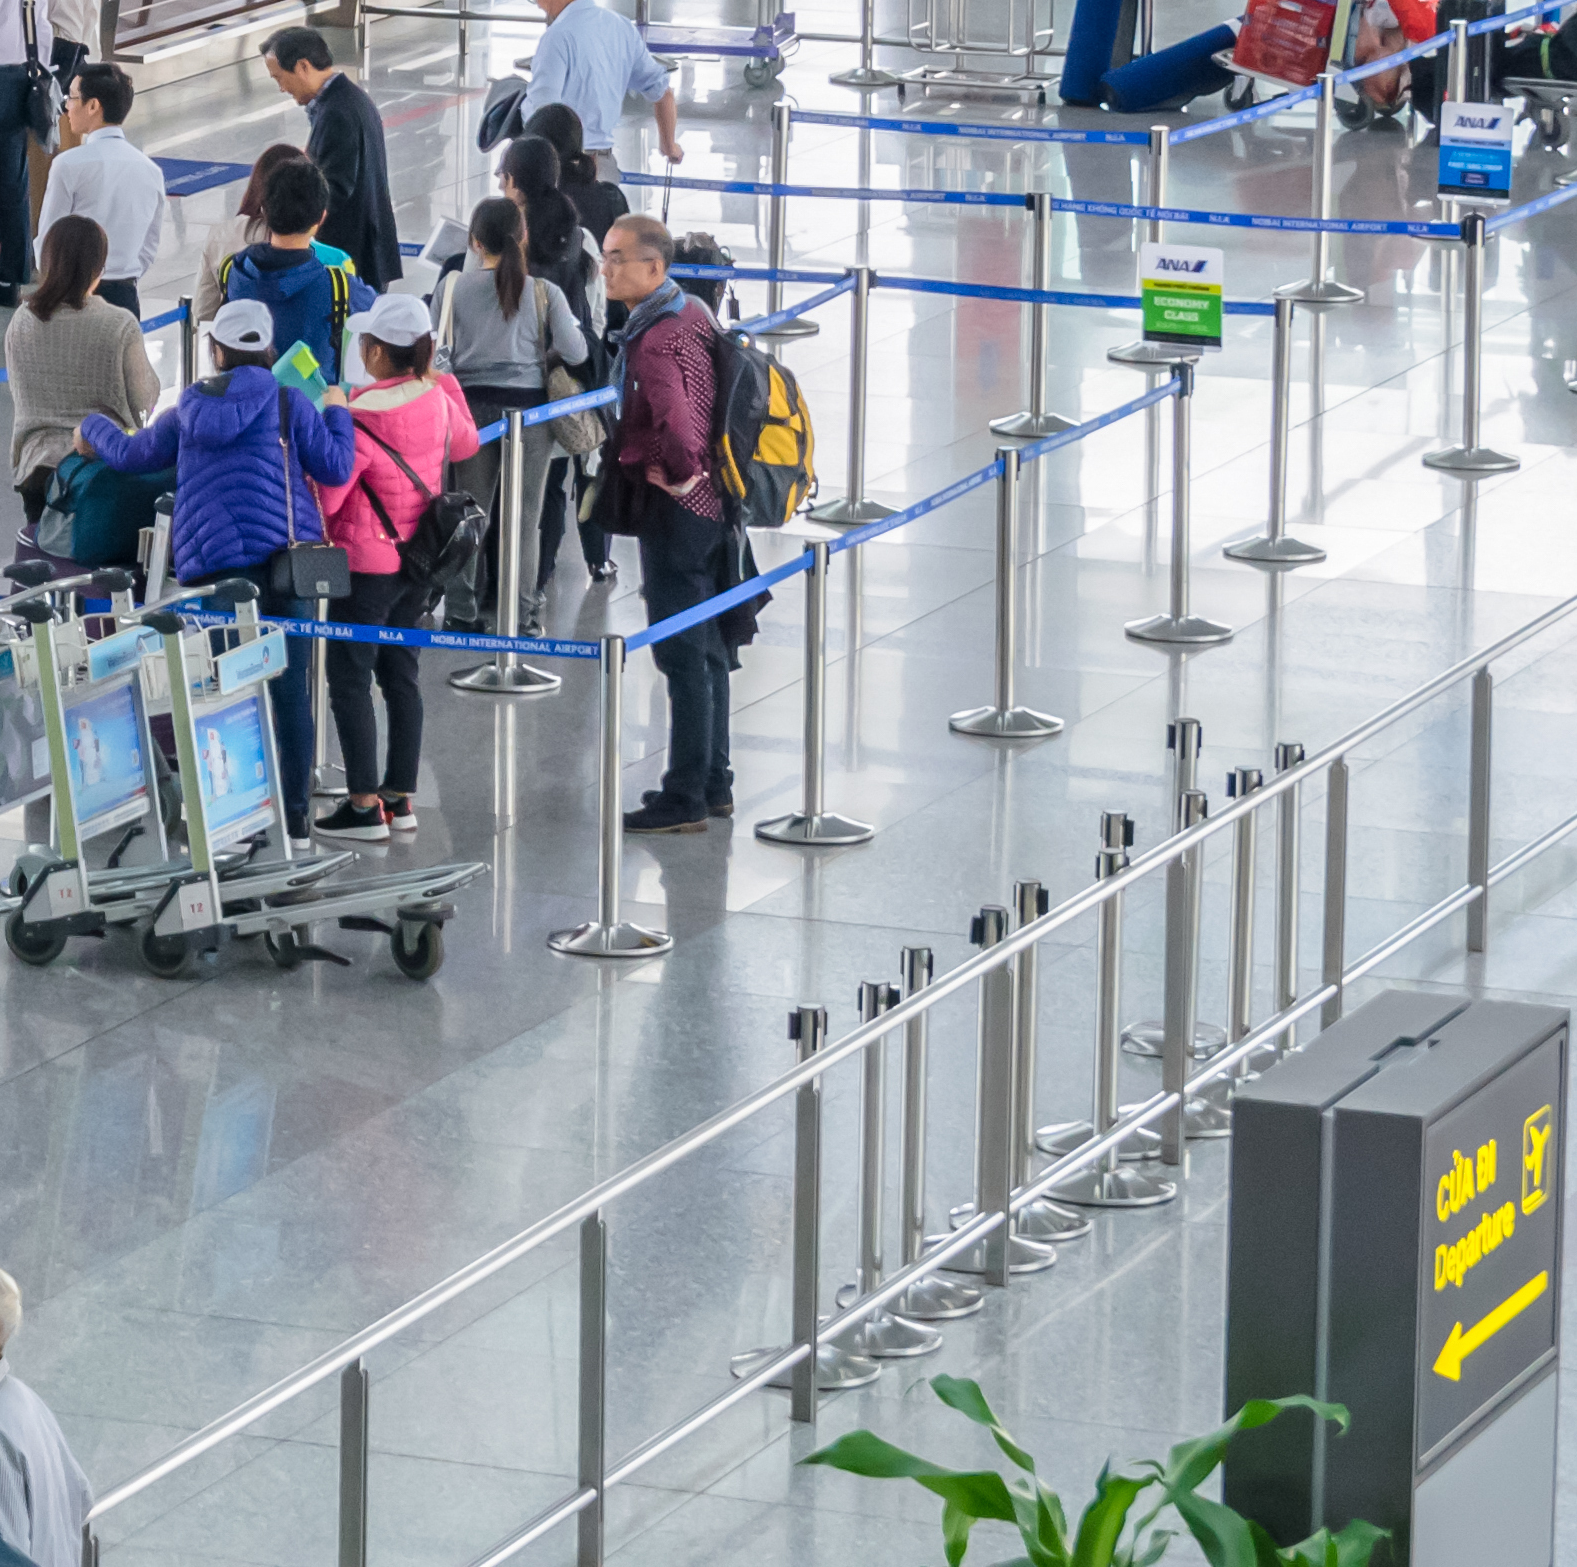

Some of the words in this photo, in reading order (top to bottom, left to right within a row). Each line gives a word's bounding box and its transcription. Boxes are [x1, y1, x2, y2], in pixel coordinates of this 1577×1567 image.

[1453, 116, 1485, 129] ANA
[1155, 258, 1189, 272] ANA
[1154, 296, 1209, 310] ECONOMY
[1164, 310, 1199, 322] CLASS
[379, 629, 403, 642] N.I.A
[431, 634, 465, 647] NOIBAI
[468, 638, 552, 653] INTERNATIONAL
[554, 643, 598, 656] AIRPORT
[1436, 1149, 1476, 1223] CỬA
[1477, 1138, 1497, 1194] ĐI
[1434, 1201, 1516, 1292] Departure
